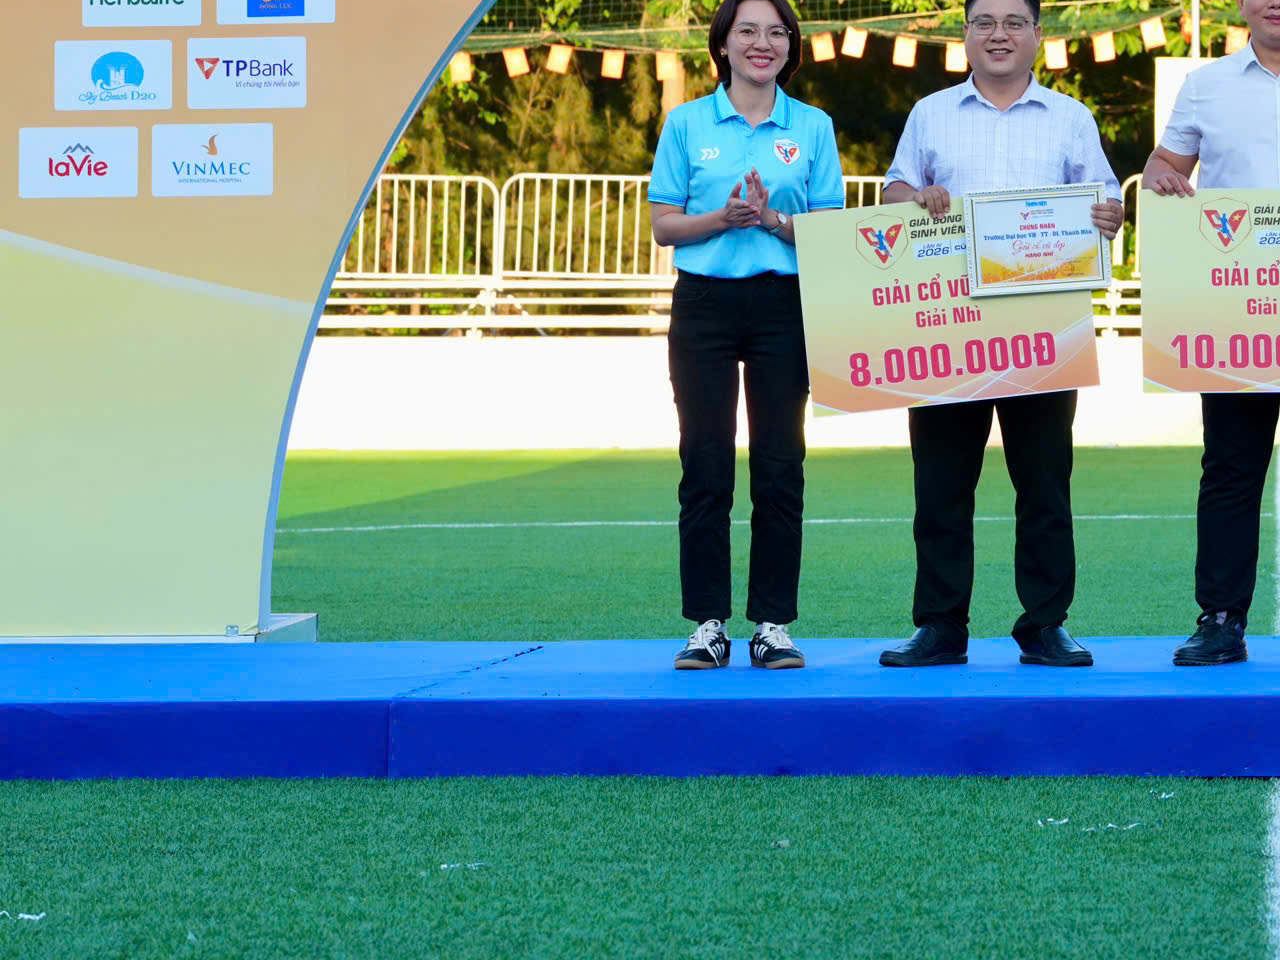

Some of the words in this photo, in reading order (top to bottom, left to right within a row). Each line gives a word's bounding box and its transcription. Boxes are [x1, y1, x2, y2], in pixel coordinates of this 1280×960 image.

[222, 59, 294, 77] TPBank
[131, 91, 156, 101] D20
[49, 154, 108, 177] laVie
[1254, 205, 1275, 214] GIẢI
[1254, 217, 1280, 226] SINH
[910, 228, 937, 239] SINH
[940, 224, 966, 236] VIÊN
[917, 246, 950, 258] 2026
[1211, 261, 1248, 287] GIẢI
[1256, 260, 1280, 287] CỔ
[872, 278, 911, 306] GIẢI
[917, 273, 943, 303] CỔ
[1246, 297, 1277, 315] Giải
[915, 308, 948, 329] Giải
[953, 306, 982, 326] Nhì
[849, 331, 1056, 388] 8.000.000Đ
